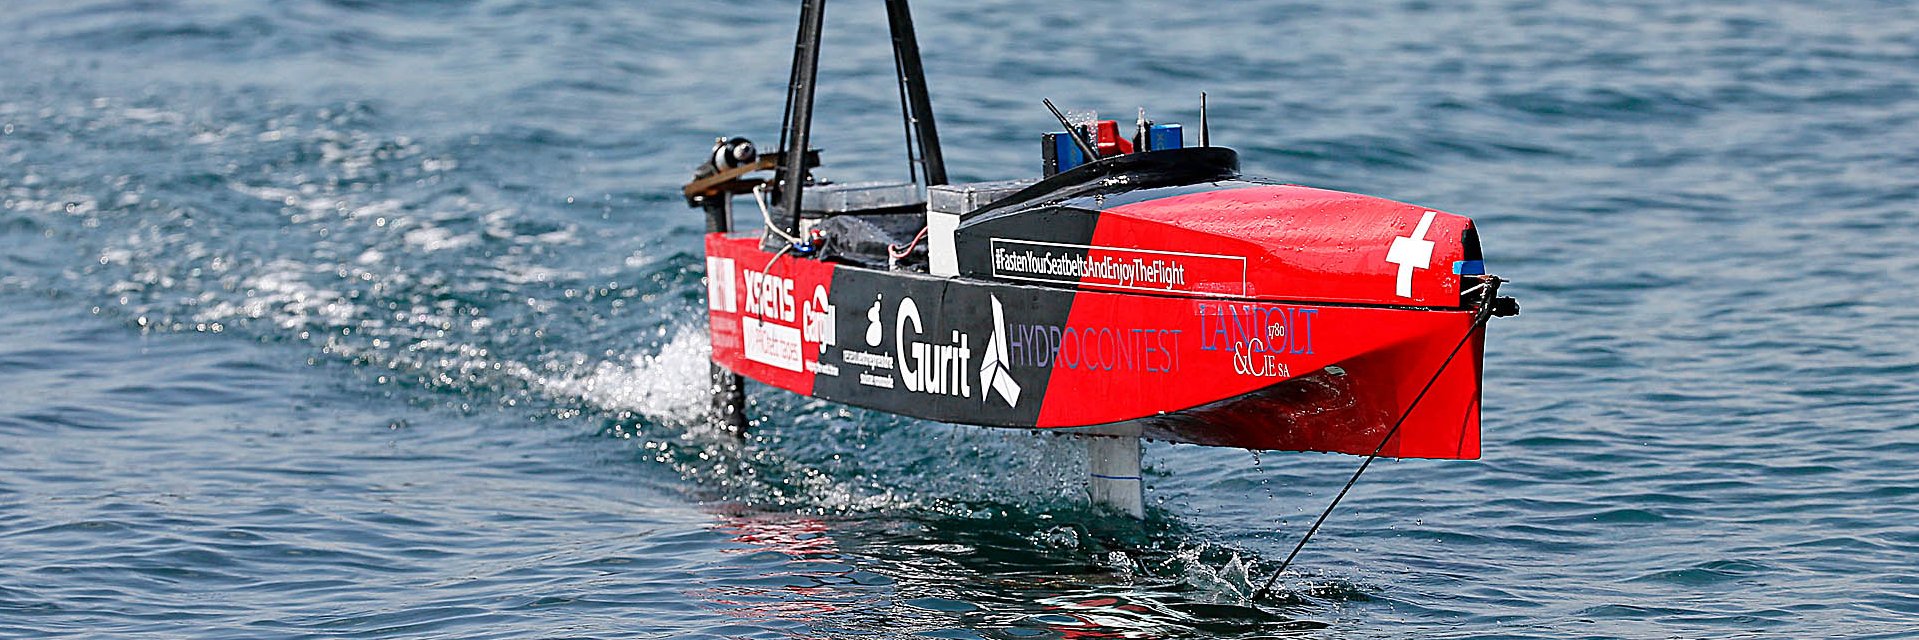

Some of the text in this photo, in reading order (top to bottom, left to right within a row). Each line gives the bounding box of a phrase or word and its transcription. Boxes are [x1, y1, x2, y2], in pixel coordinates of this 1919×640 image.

[995, 247, 1185, 290] #FastenYourSeatbeltsAndEnjoyTheFlight
[743, 269, 796, 323] xsens
[896, 296, 971, 398] Gurit
[1009, 323, 1182, 373] HYDROCONTEST
[1199, 303, 1319, 354] LANDOLT
[1267, 322, 1285, 340] 1780
[1277, 363, 1290, 378] SA
